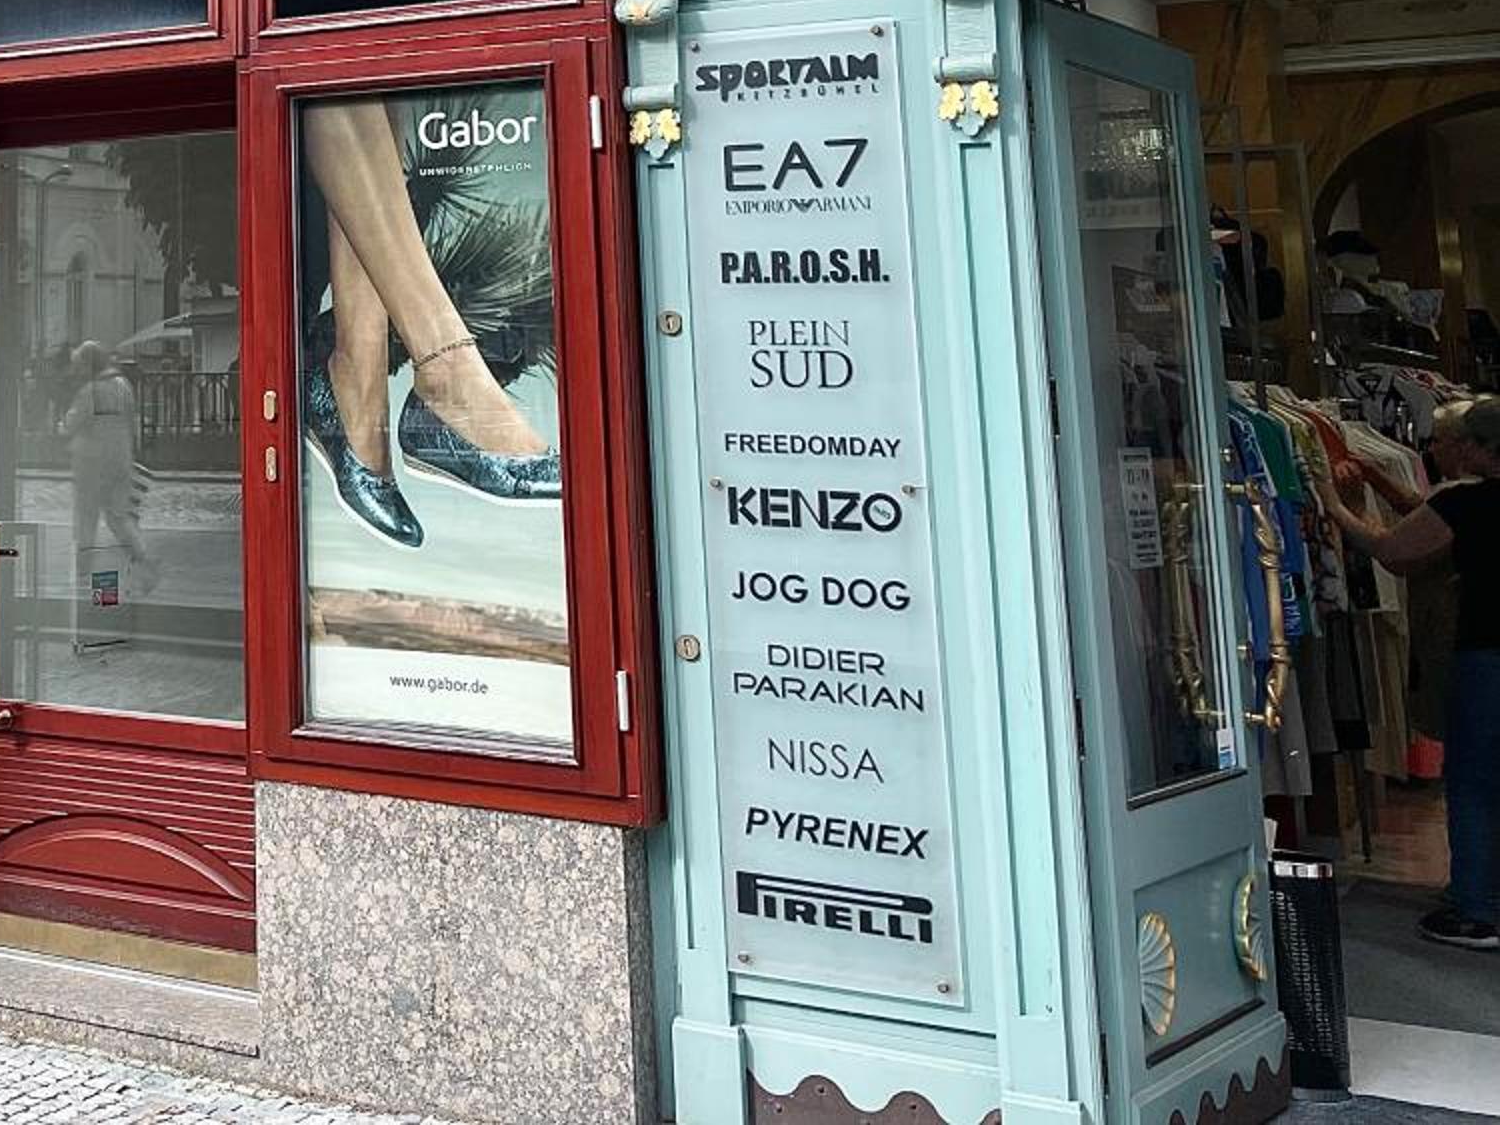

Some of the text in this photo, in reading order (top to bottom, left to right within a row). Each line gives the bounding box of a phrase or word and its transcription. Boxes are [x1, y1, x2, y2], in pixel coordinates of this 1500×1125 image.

[695, 52, 879, 102] SPORTALM
[418, 108, 537, 150] Gabor
[723, 138, 868, 192] EA7
[725, 195, 872, 216] EMPORIO ARMANI
[720, 248, 891, 284] P.A.R.O.S.H.
[748, 320, 850, 347] PLEIN
[750, 349, 853, 389] SUD
[724, 432, 901, 458] FREEDOMDAY
[727, 486, 902, 533] KENZO
[732, 571, 911, 611] JOG DOG
[767, 644, 885, 675] DIDIER
[389, 675, 489, 695] www.gabor.de
[733, 672, 924, 712] PARAKIAN
[768, 738, 884, 783] NISSA
[745, 807, 929, 859] PYRENEX
[736, 870, 933, 943] PIRELLI
